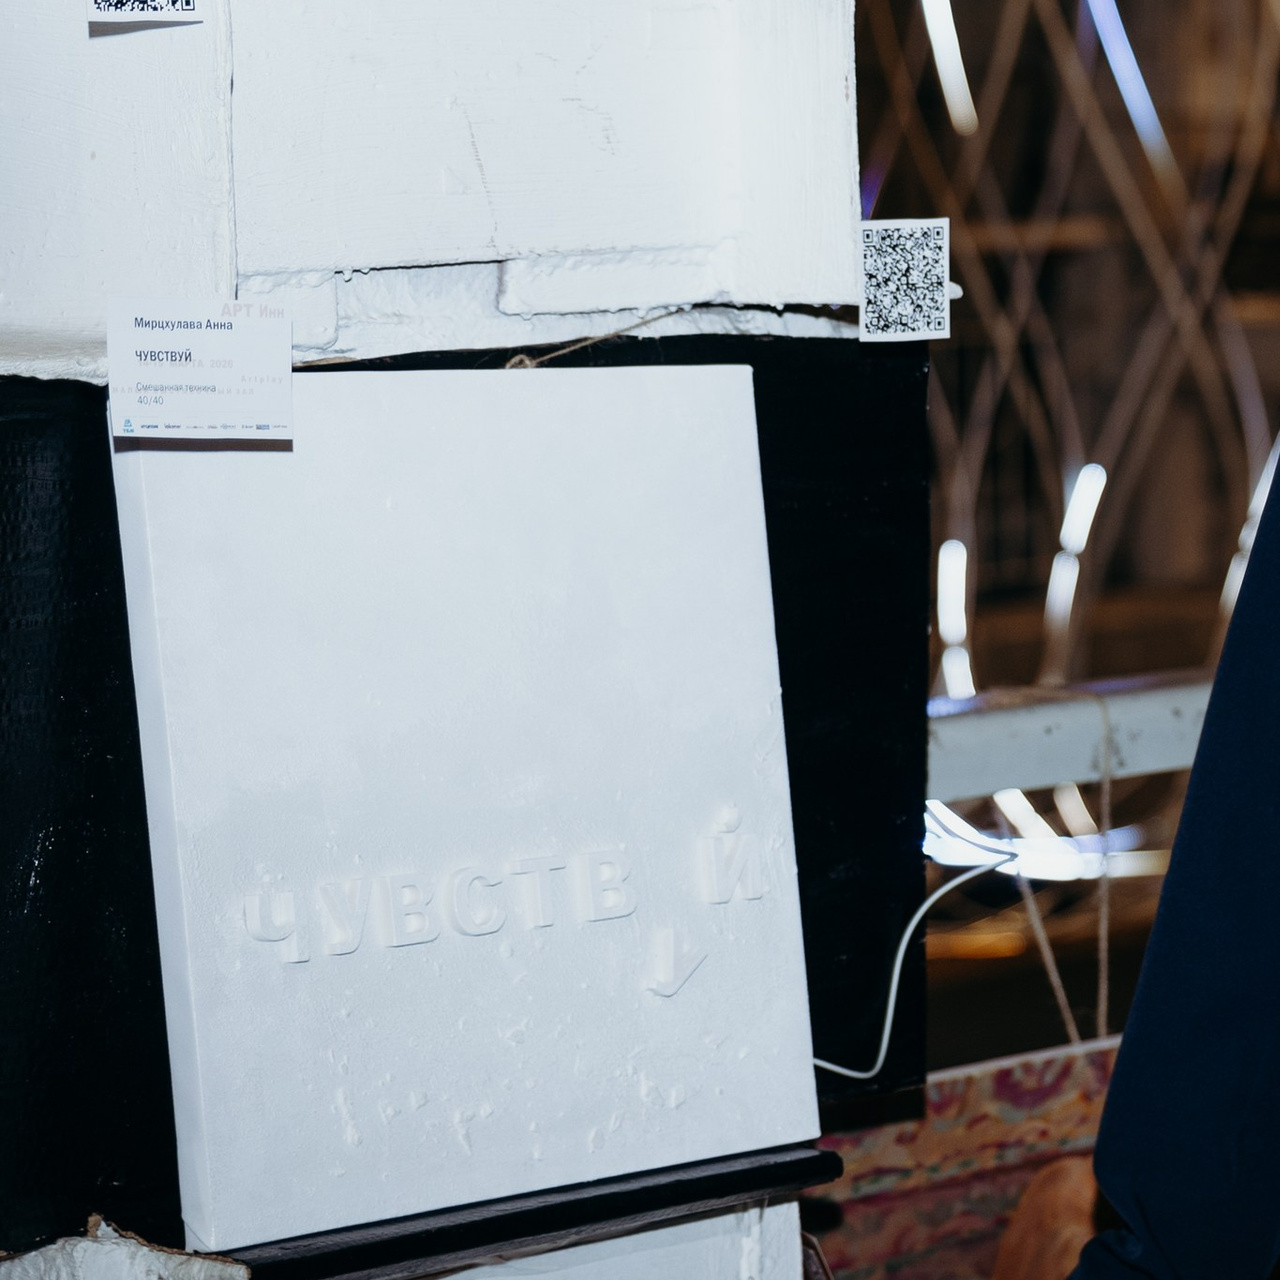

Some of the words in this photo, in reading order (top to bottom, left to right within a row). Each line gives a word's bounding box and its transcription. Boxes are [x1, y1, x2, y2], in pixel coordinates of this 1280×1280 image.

[221, 303, 254, 317] АРТ
[259, 305, 285, 318] Инн
[134, 317, 202, 331] Мирцхулава
[205, 319, 233, 330] Анна
[135, 349, 192, 362] ЧУВСТВУЙ
[241, 375, 283, 384] Artplay
[136, 382, 183, 392] Смешанная
[185, 384, 217, 392] техника
[137, 396, 164, 406] 40/40
